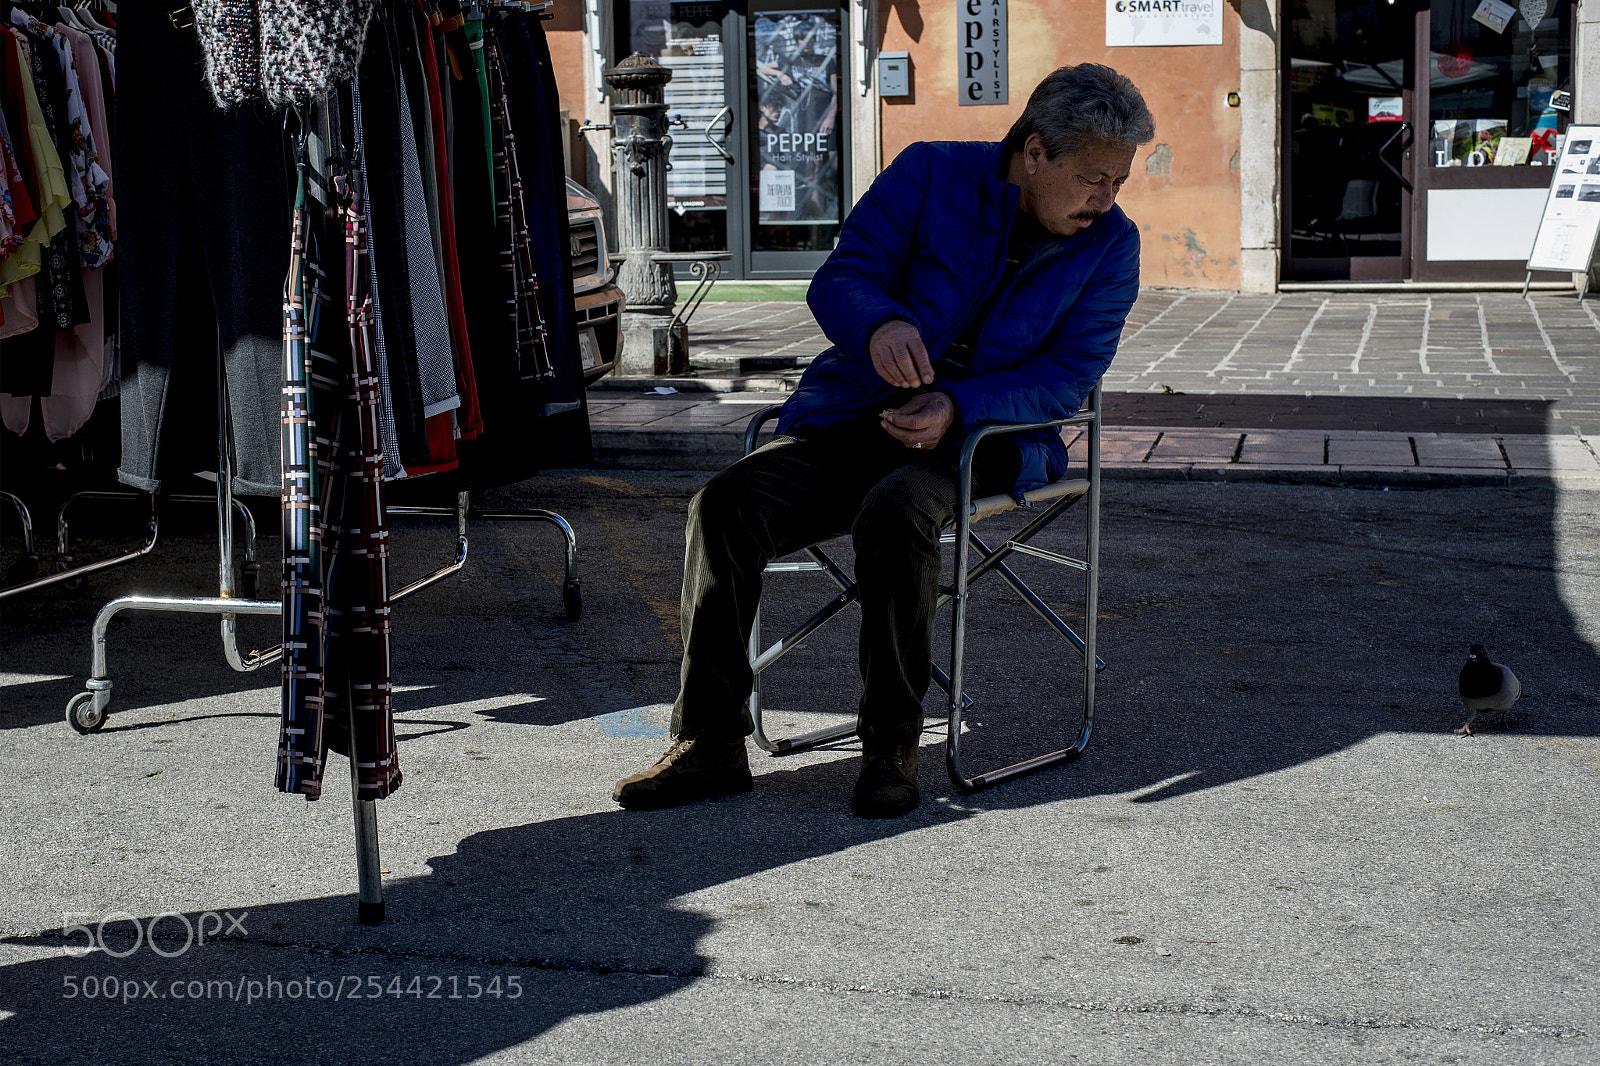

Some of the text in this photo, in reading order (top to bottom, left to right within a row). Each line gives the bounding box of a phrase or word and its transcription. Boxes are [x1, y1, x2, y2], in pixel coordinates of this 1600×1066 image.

[767, 132, 828, 153] PEPPE
[772, 152, 824, 164] Hair Stylist
